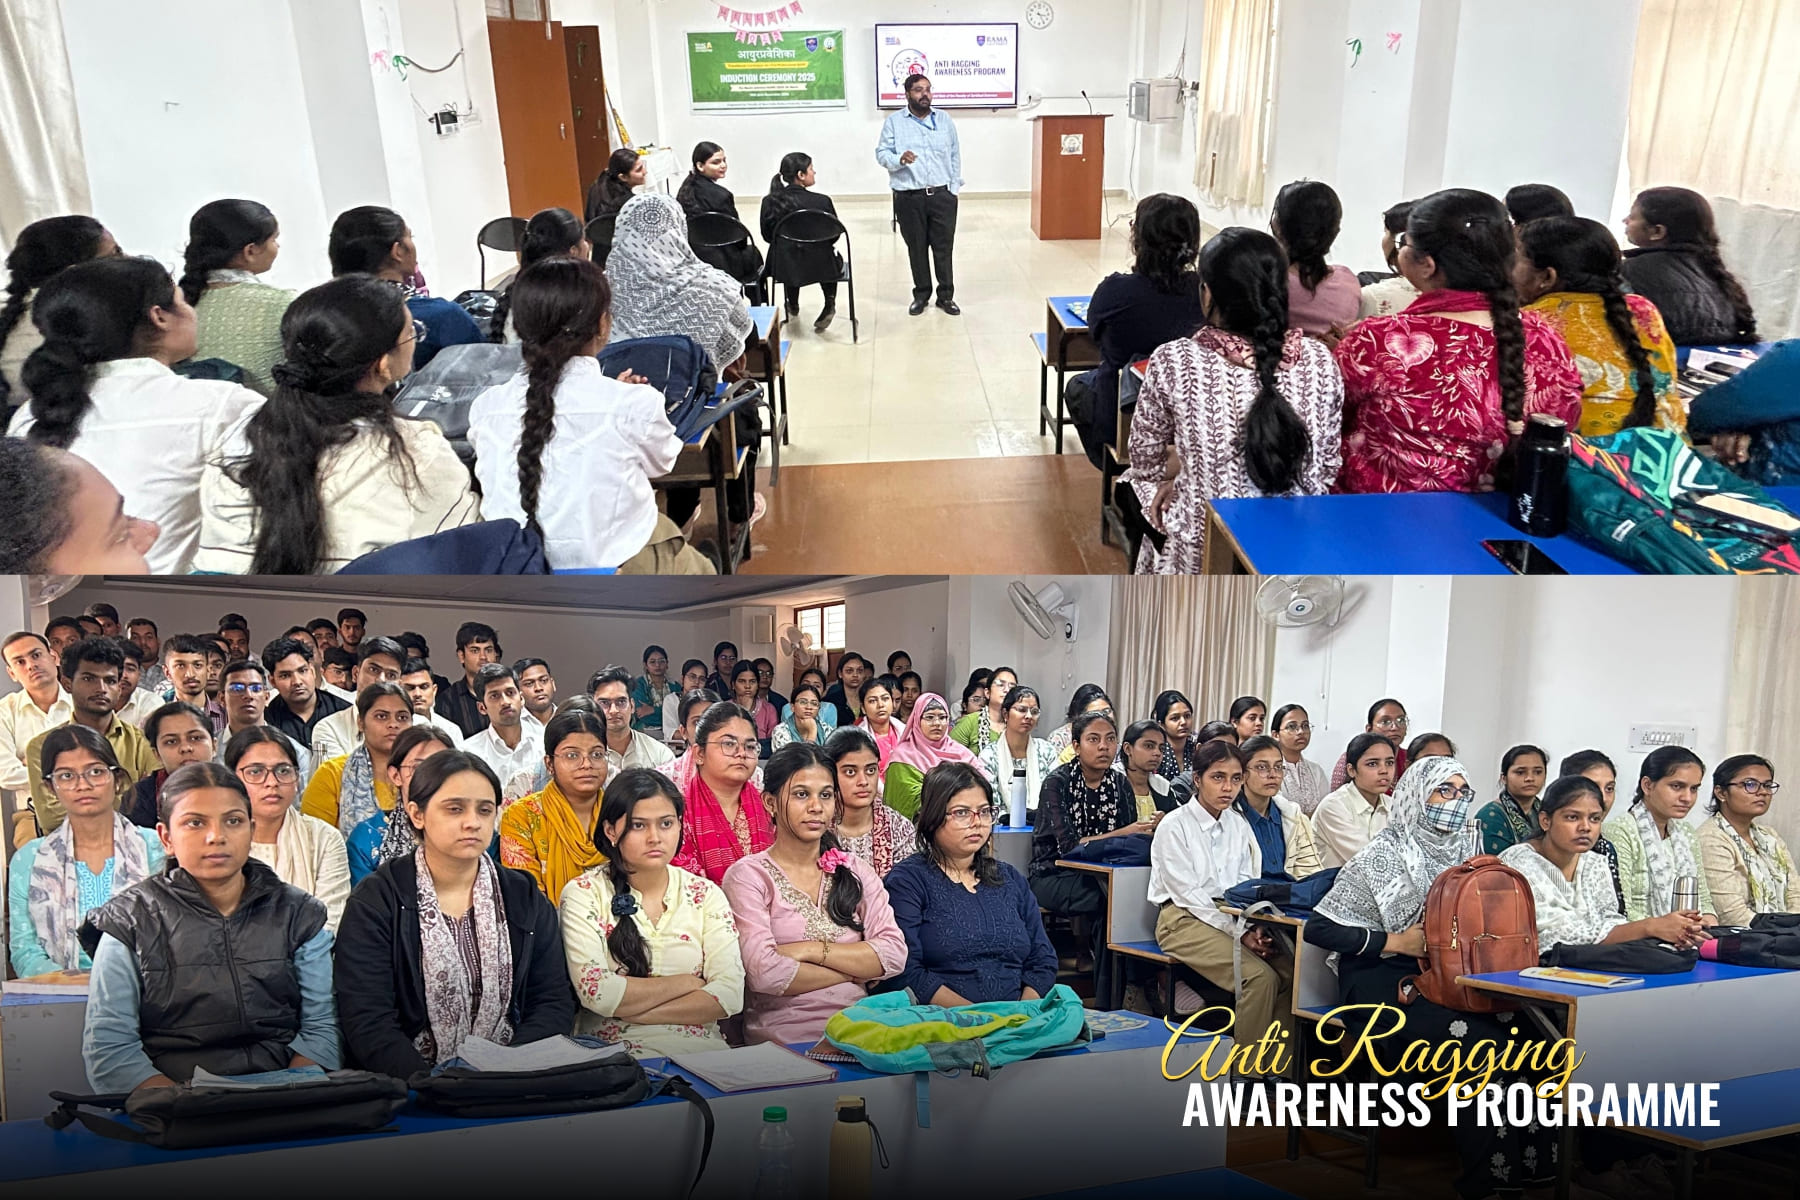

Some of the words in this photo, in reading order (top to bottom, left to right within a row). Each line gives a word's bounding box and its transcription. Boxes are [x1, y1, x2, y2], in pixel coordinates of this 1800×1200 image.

[934, 60, 949, 68] ANTI
[951, 60, 981, 68] RAGGING
[934, 68, 972, 76] AWARENESS
[973, 67, 1006, 76] PROGRAM
[720, 74, 758, 83] INDUCTION
[759, 73, 796, 82] CEREMONY
[797, 72, 816, 82] 2025
